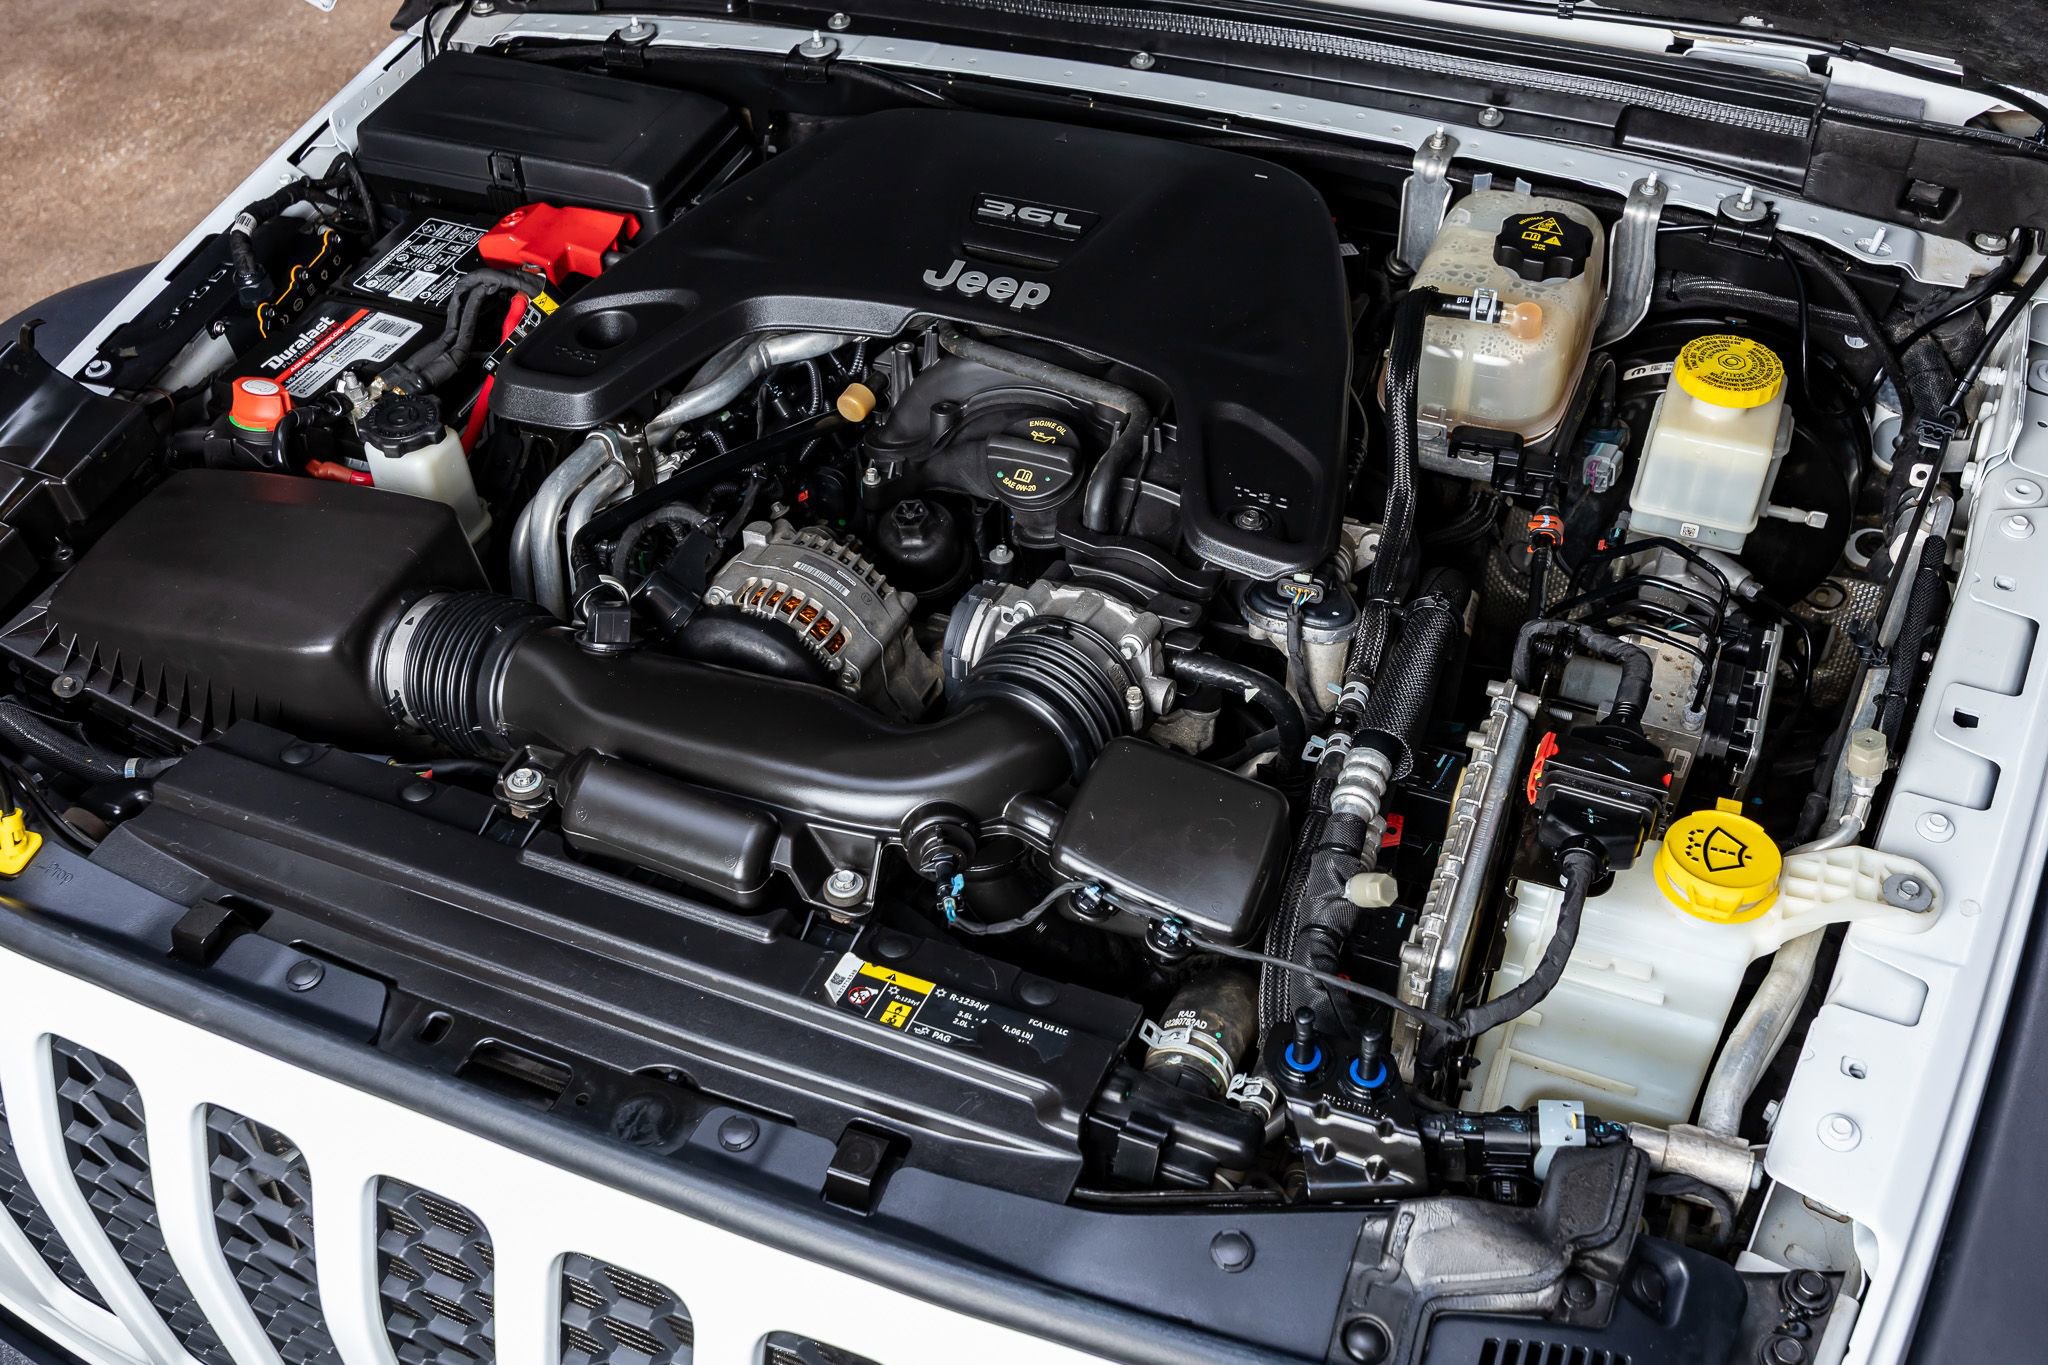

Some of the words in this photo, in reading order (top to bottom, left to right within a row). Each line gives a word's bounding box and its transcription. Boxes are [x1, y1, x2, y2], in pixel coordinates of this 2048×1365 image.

[977, 198, 1082, 233] 3.6L
[922, 259, 1051, 312] Jeep
[260, 315, 335, 370] Duralast
[289, 357, 307, 373] AGM
[306, 325, 348, 359] TECHNOLOGY
[282, 340, 317, 369] PLATINUM
[1029, 420, 1057, 429] ENGINE
[1055, 425, 1067, 436] OIL
[1002, 477, 1017, 489] SAE
[1015, 483, 1037, 492] 0W-20
[894, 994, 921, 1006] R-1234yf
[949, 993, 990, 1012] R-1234yf
[952, 1017, 968, 1028] 2.0L
[957, 1010, 973, 1021] 3.6L
[1177, 1010, 1197, 1018] RAD
[1028, 1018, 1043, 1029] FCA
[1043, 1023, 1055, 1032] US
[1054, 1027, 1069, 1036] LLC
[931, 1030, 952, 1043] PAG
